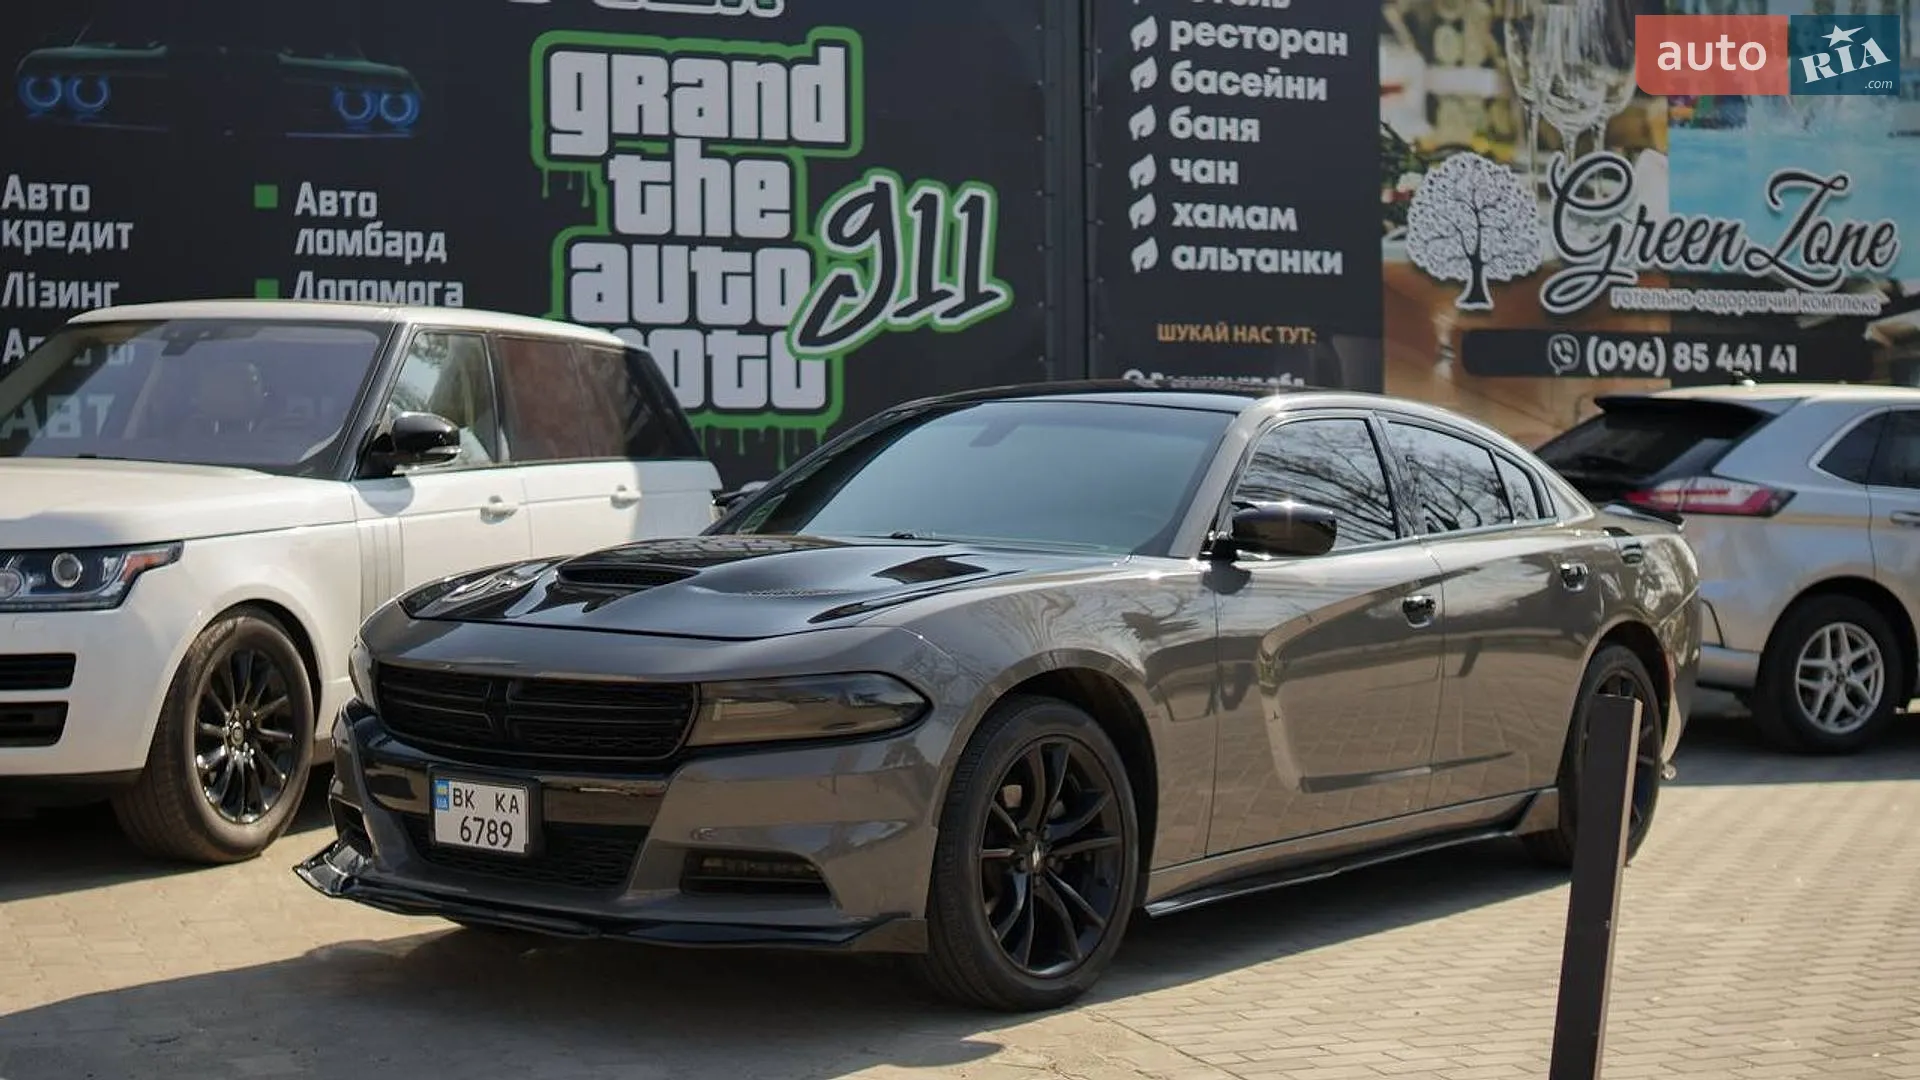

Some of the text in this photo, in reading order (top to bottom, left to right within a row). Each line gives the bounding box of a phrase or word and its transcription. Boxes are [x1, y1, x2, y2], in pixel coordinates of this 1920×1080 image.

[1169, 19, 1349, 59] ресторан
[1169, 60, 1328, 101] басейни
[1168, 106, 1260, 142] баня
[608, 137, 790, 239] the
[1169, 157, 1239, 185] чан
[1, 174, 91, 211] Авто
[294, 181, 377, 218] Авто
[1171, 202, 1298, 232] хамам
[1542, 153, 1899, 311] Green Zone
[1, 219, 134, 256] кредит
[294, 221, 447, 265] ломбард
[1171, 244, 1343, 275] альтанки
[1, 271, 120, 309] Лізинг
[293, 270, 464, 307] Допомога
[570, 242, 811, 327] auto
[1157, 321, 1316, 344] ШУКАЙ НАС ТУТ:
[612, 328, 826, 409] oto
[1586, 335, 1797, 377] (096) 85 441 41
[453, 788, 519, 815] BK KA
[460, 815, 513, 848] 6789
